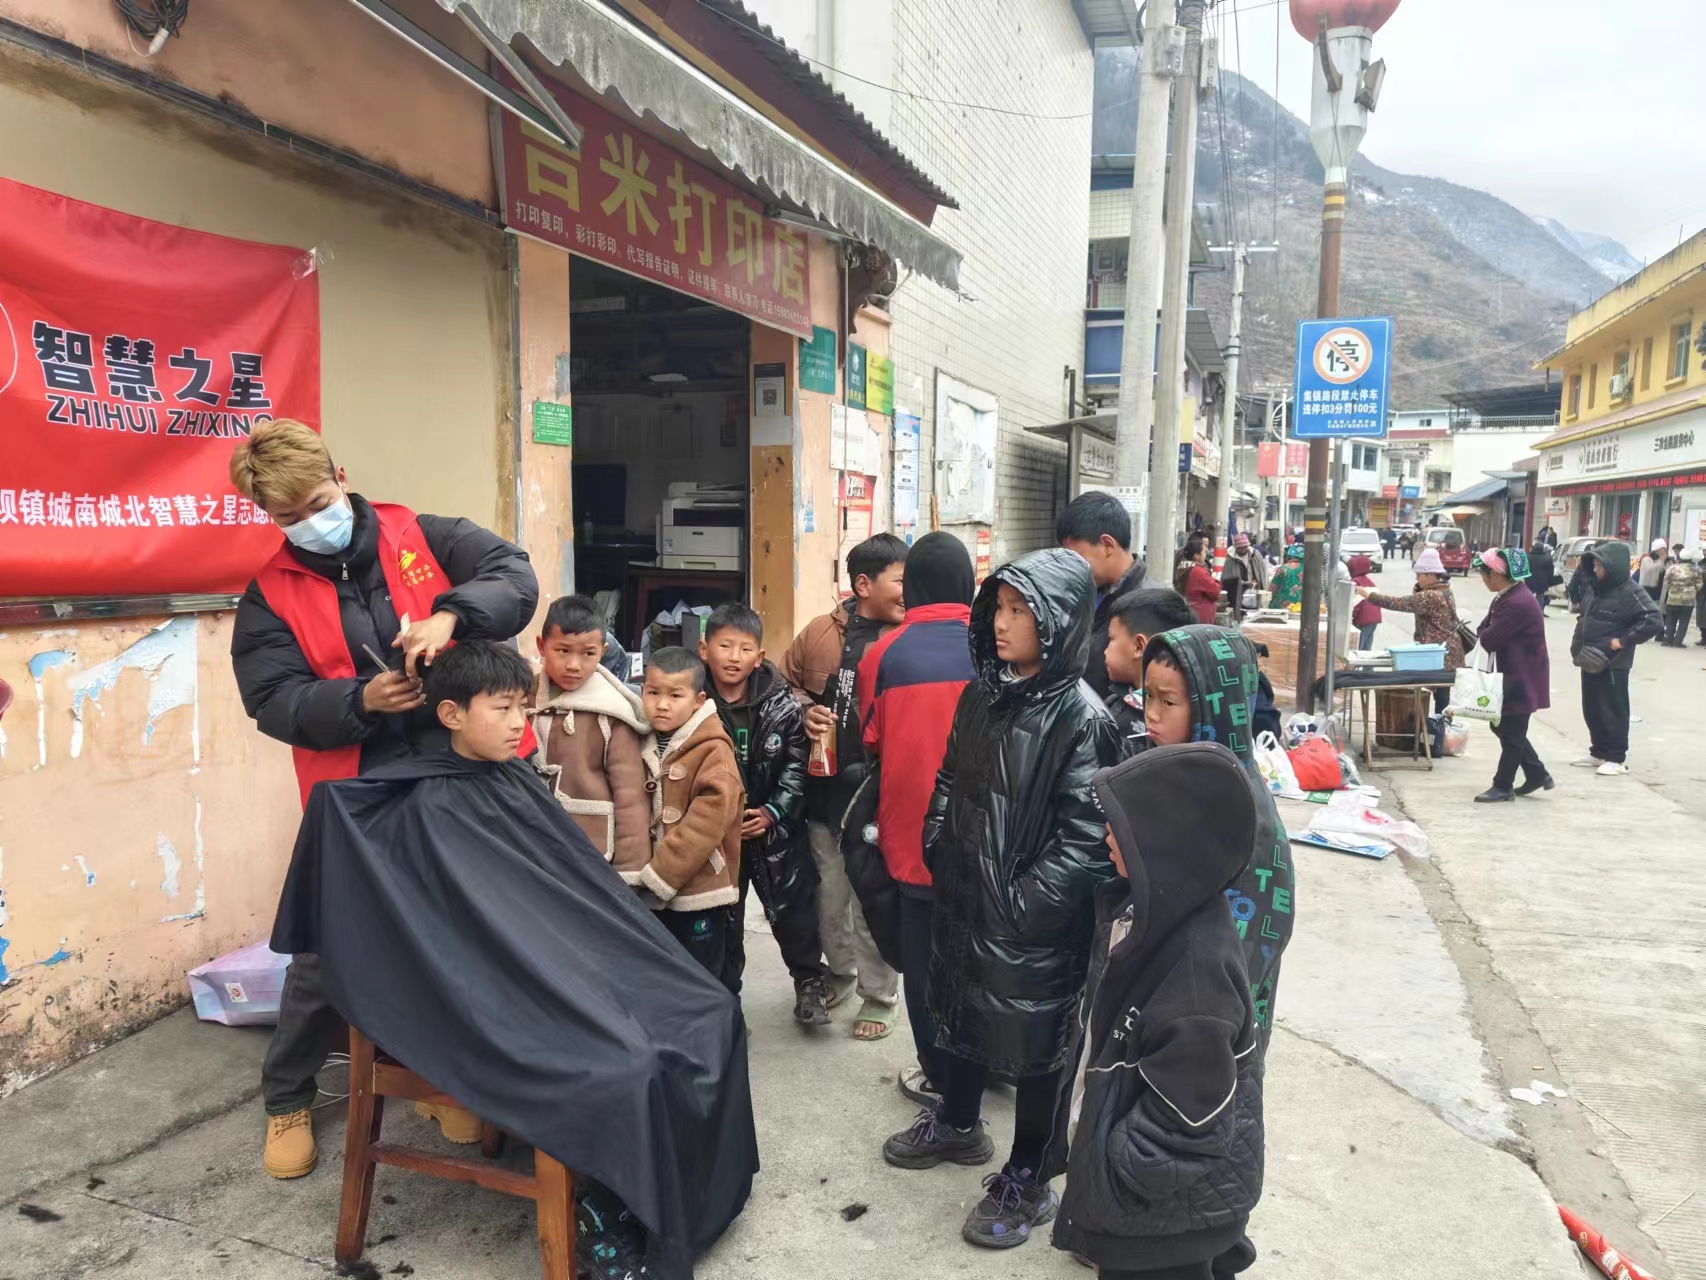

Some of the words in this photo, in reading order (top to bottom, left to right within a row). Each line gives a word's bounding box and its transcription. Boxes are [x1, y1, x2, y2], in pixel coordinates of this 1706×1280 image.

[32, 320, 272, 409] 智慧之星
[46, 394, 158, 434] ZHIHUI
[1302, 402, 1378, 415] 违停扣3分罚100元
[1303, 388, 1378, 402] 集镇路段禁止停车
[0, 488, 275, 528] 坝镇城南城北智慧之星志愿
